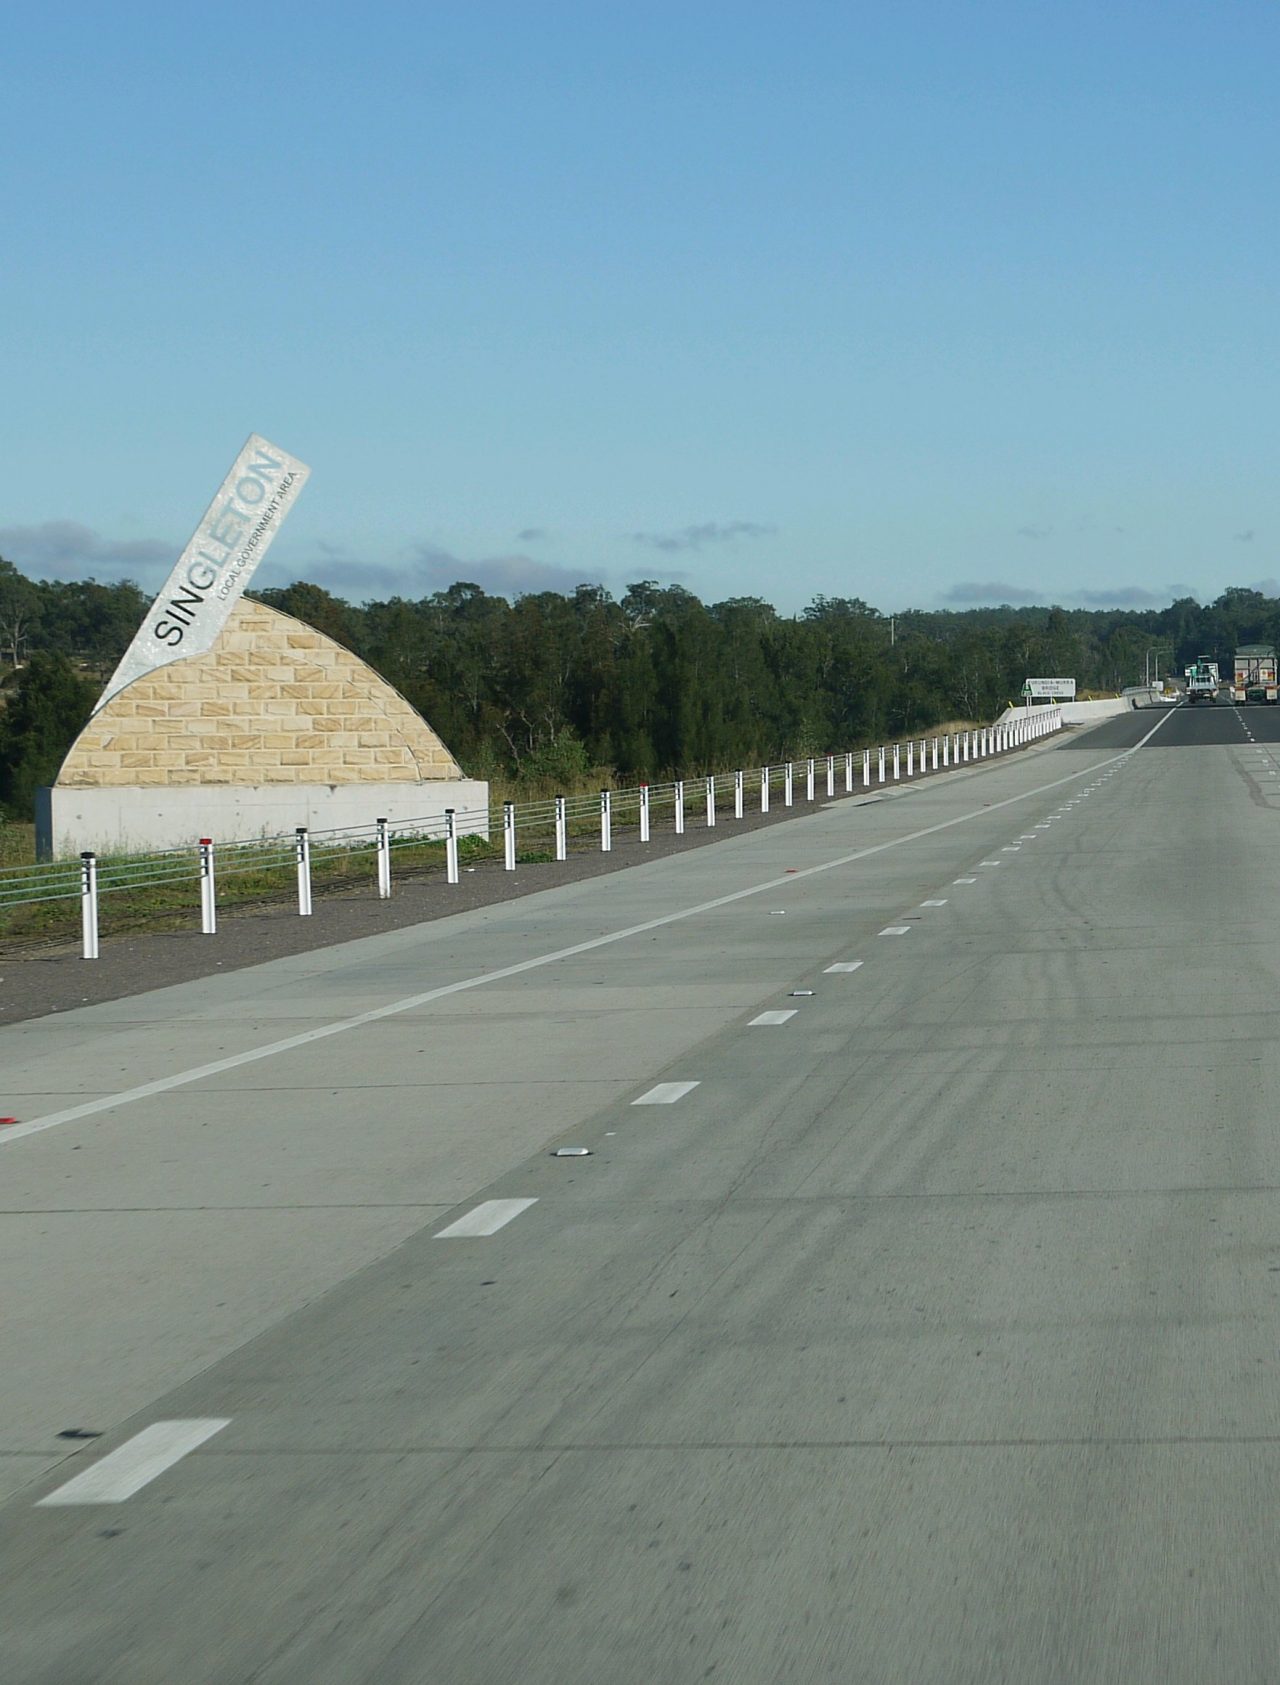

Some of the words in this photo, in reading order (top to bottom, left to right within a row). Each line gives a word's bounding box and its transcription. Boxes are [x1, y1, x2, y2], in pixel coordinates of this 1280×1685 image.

[154, 450, 283, 646] SINGLETON
[217, 569, 241, 601] LOCAL
[237, 497, 280, 568] GOVERNMENT
[279, 471, 297, 499] AREA
